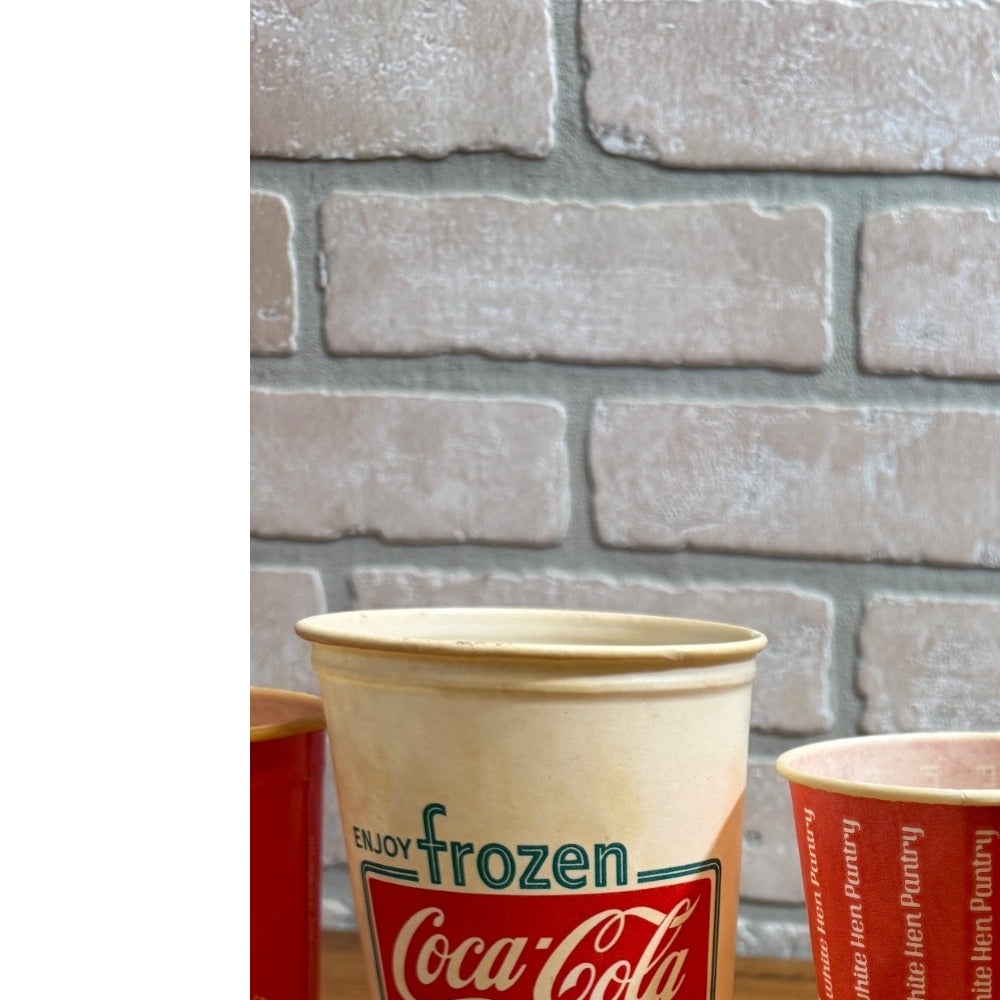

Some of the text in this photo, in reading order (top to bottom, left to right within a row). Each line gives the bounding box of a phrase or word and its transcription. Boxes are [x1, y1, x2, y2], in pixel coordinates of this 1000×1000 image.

[353, 803, 629, 890] ENJOY frozen
[804, 807, 820, 887] Pantry
[842, 818, 861, 900] Pantry
[901, 826, 925, 909] Pantry
[969, 829, 1000, 912] Pantry
[814, 891, 826, 935] Hen
[851, 902, 866, 949] Hen
[904, 911, 924, 958] Hen
[970, 915, 993, 961] Hen
